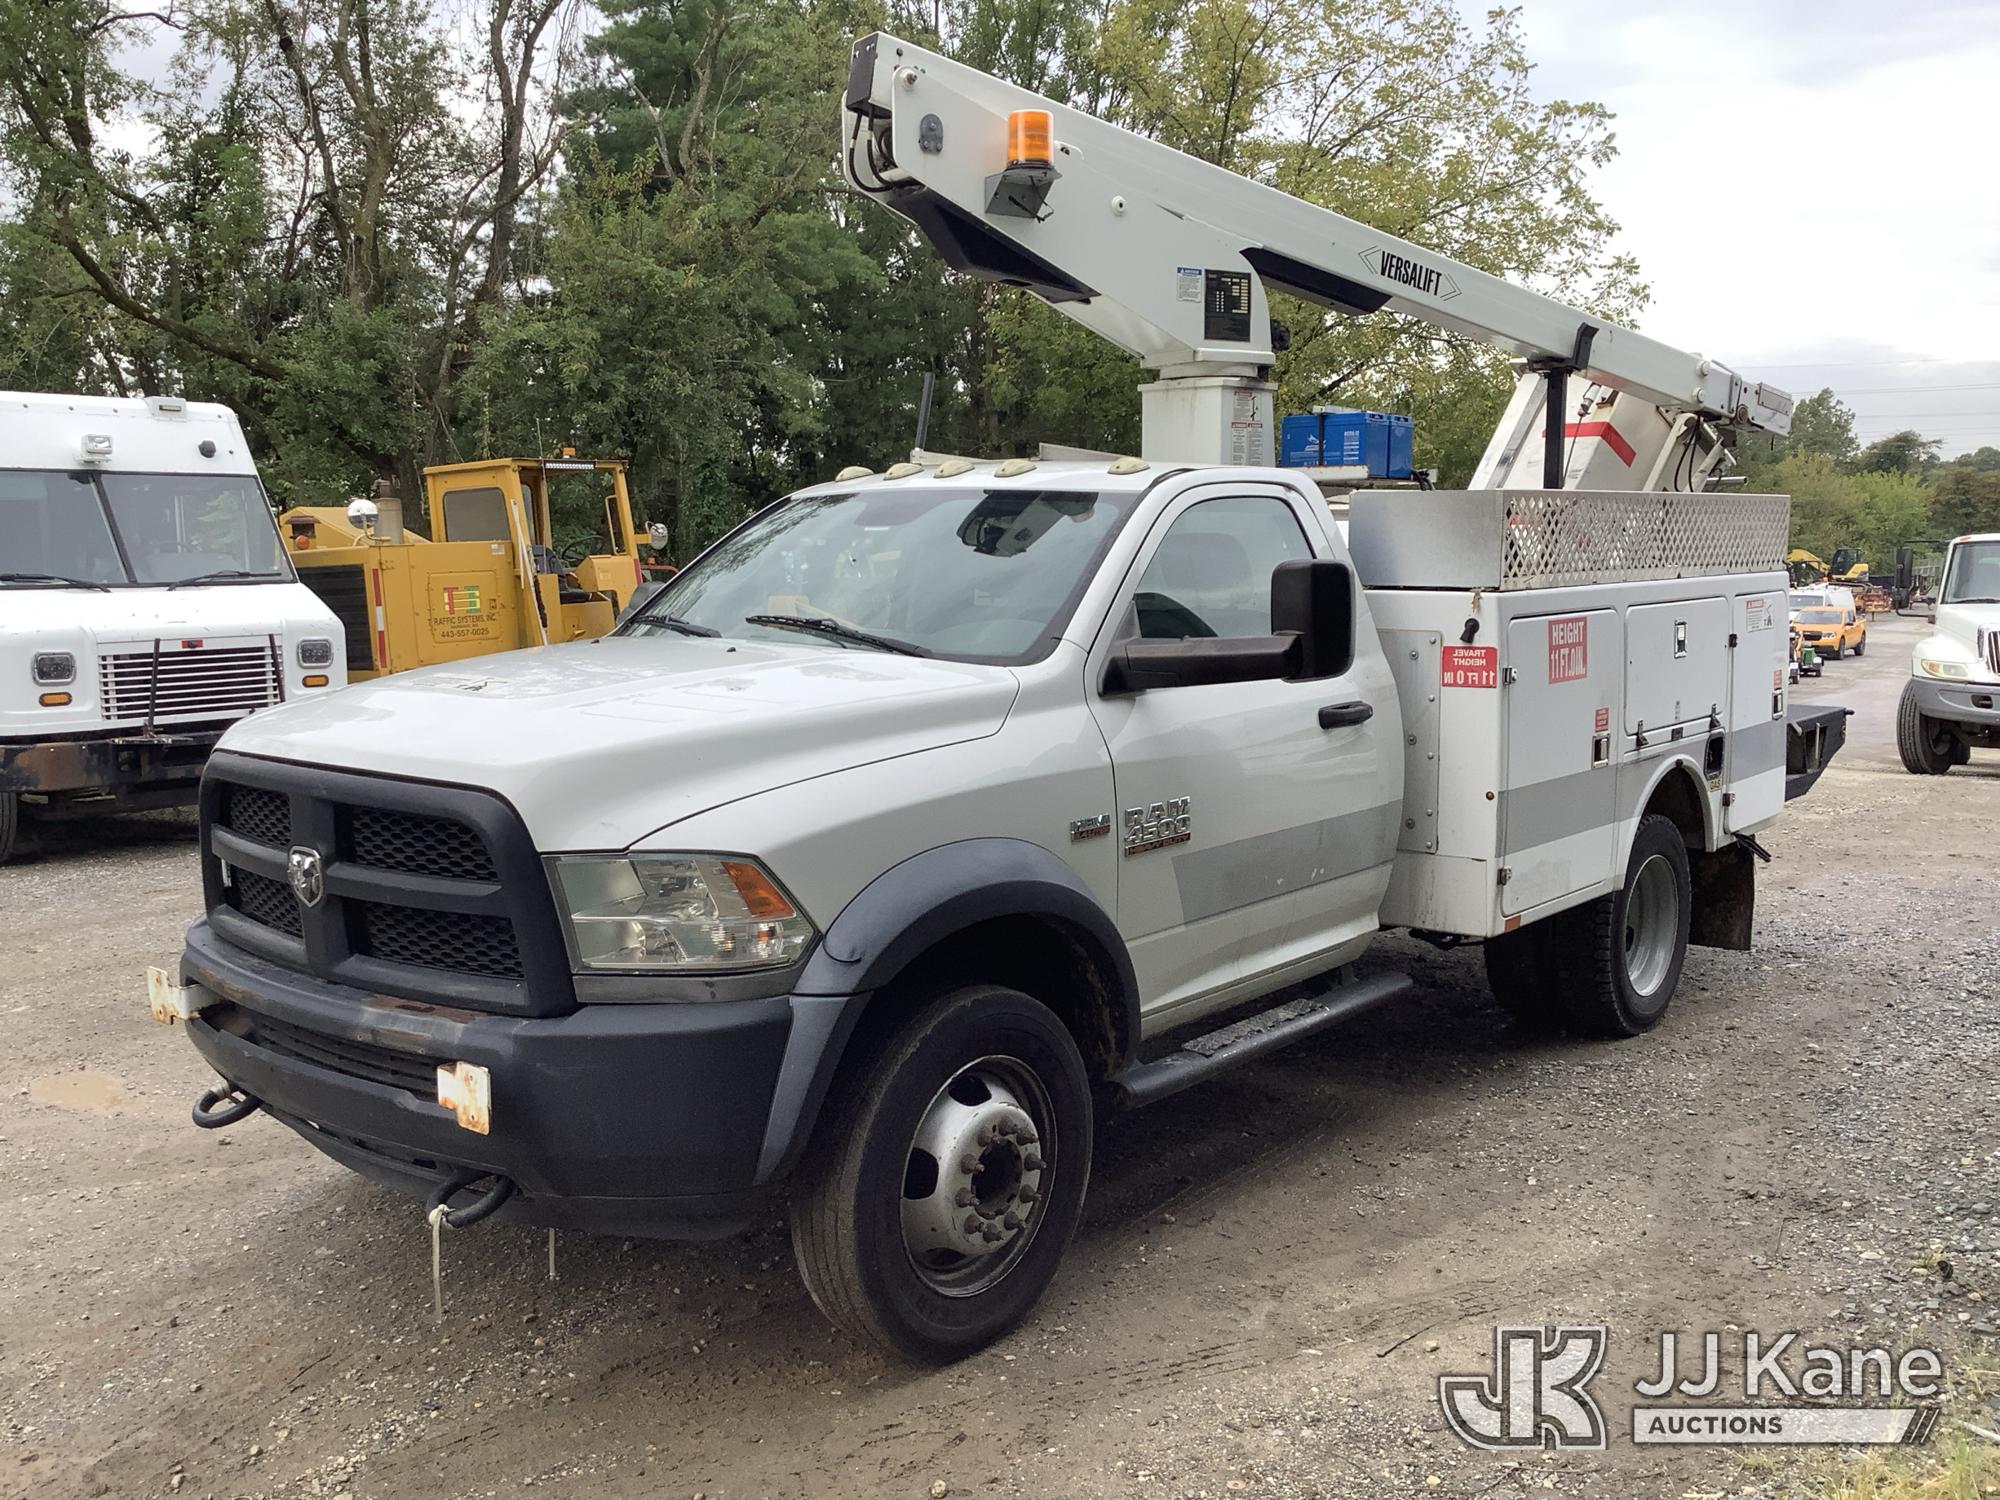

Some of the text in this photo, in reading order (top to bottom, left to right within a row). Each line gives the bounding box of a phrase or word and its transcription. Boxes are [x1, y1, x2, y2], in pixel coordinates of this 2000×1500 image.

[1380, 250, 1442, 296] VERSALIFT
[1552, 621, 1585, 646] HEIGHT
[1124, 796, 1191, 828] RAM
[1124, 814, 1191, 843] 4500
